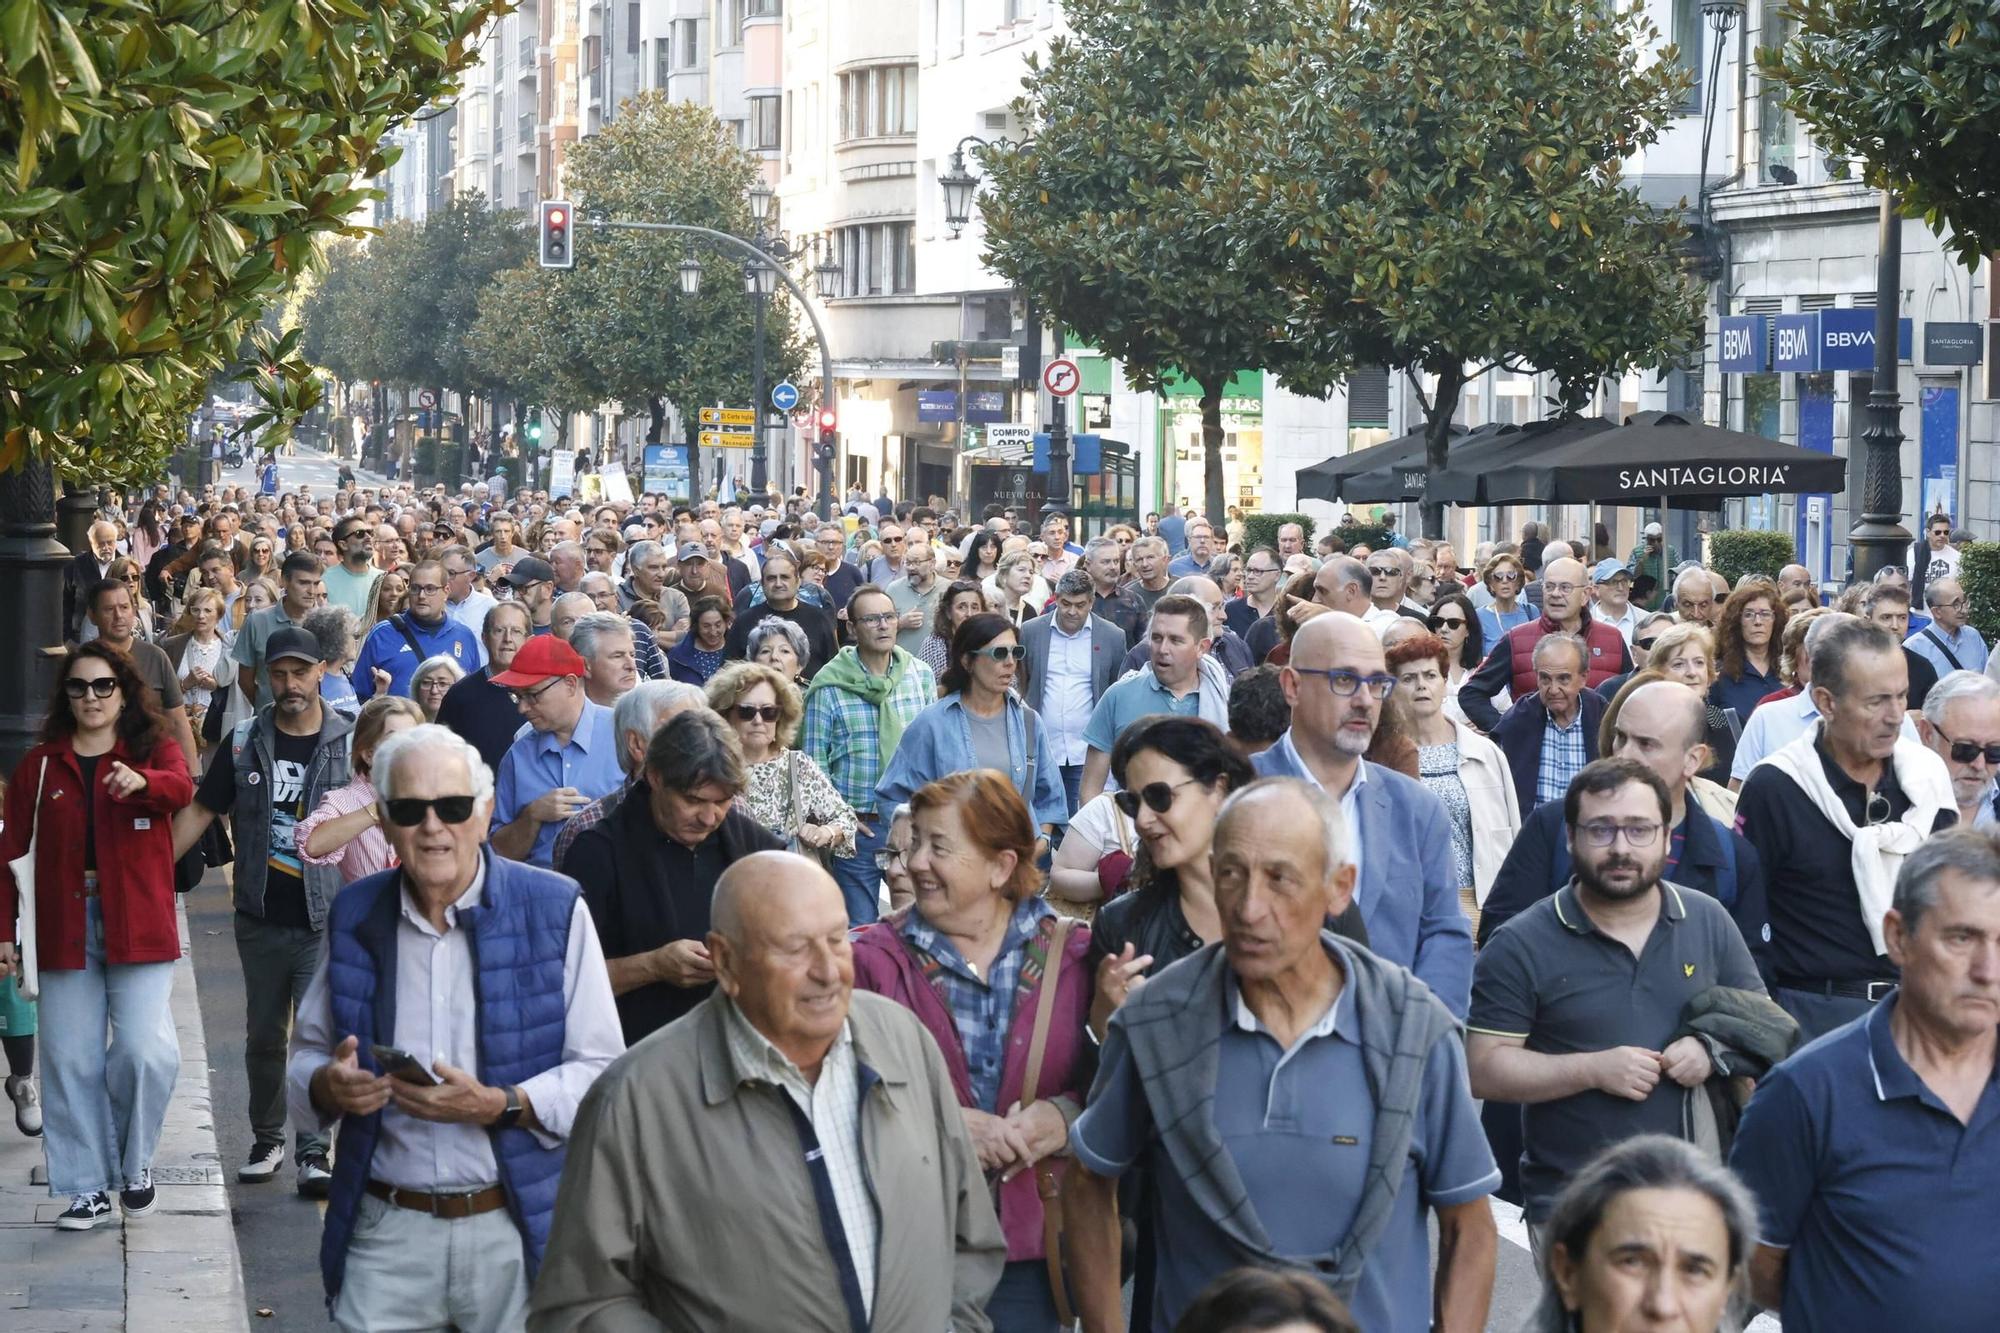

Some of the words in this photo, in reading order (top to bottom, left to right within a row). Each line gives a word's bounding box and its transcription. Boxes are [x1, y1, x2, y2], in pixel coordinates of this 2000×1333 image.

[1724, 325, 1751, 361] BBVA
[1778, 325, 1808, 360] BBVA
[1826, 330, 1875, 347] BBVA
[1235, 398, 1261, 412] LAS
[992, 428, 1031, 437] COMPRO
[1619, 466, 1786, 490] SANTAGLORIA
[993, 490, 1023, 499] NUEVO
